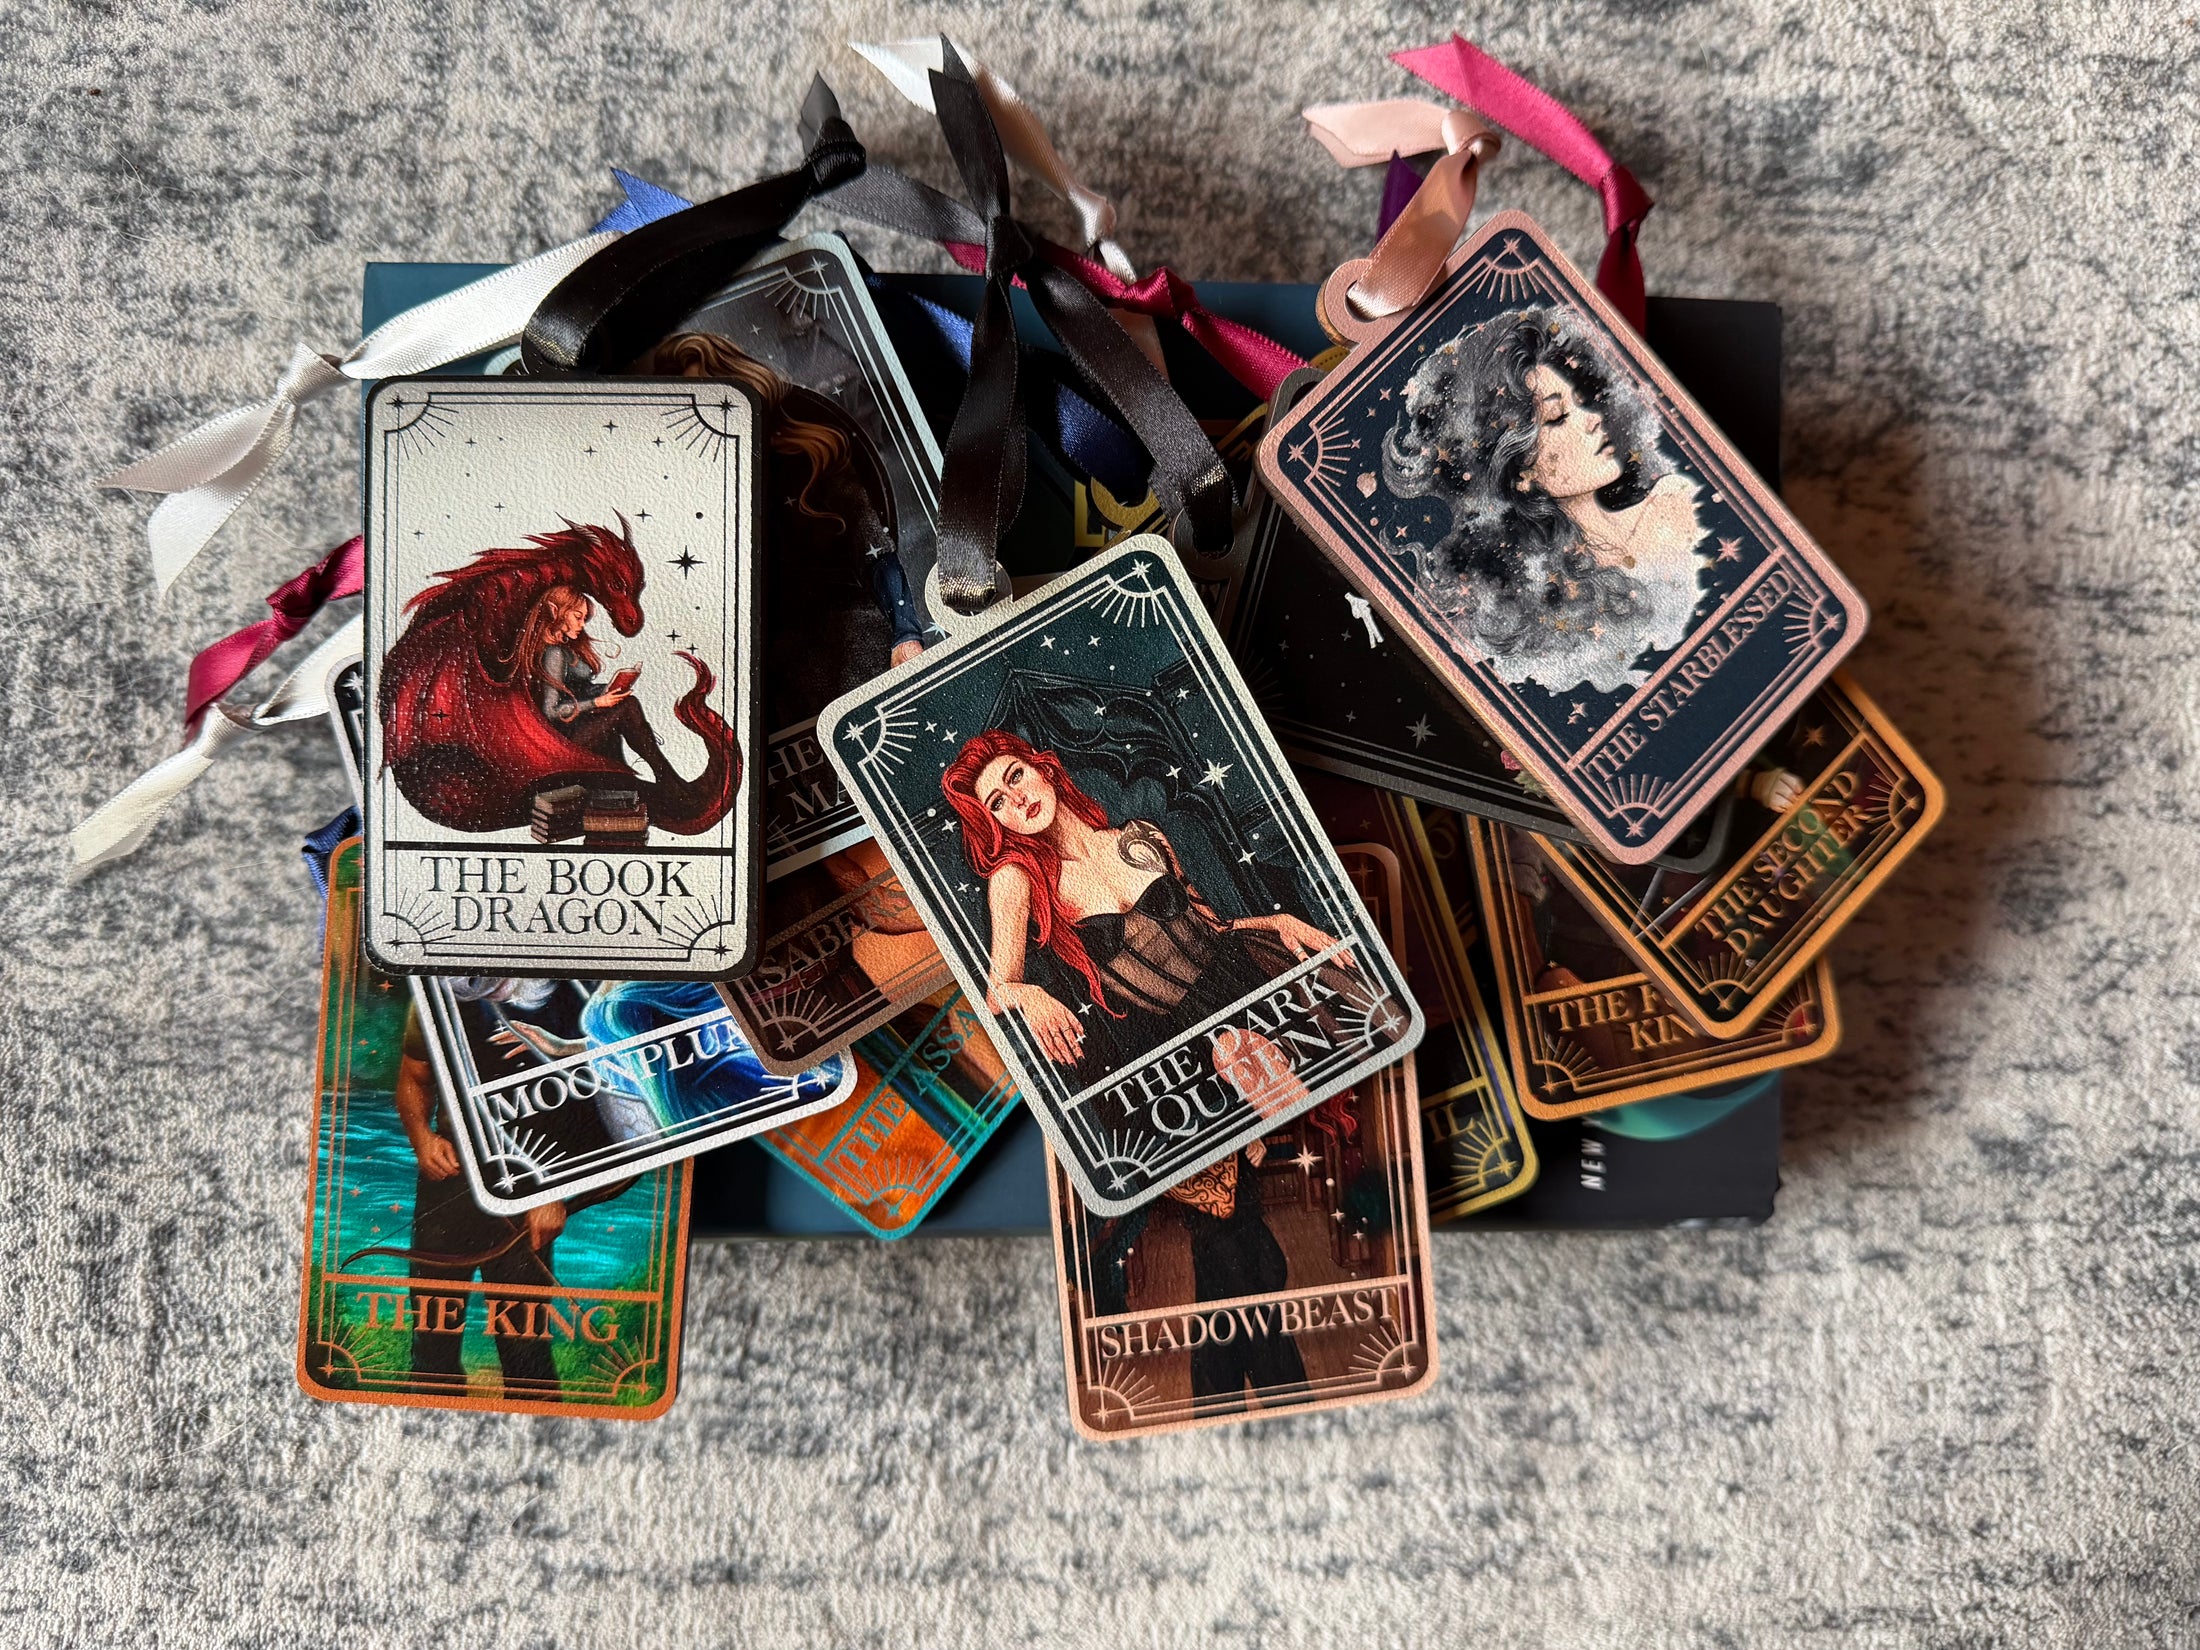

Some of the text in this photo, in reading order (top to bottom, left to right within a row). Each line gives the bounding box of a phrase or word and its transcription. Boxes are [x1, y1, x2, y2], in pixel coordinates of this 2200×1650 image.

[1585, 570, 1794, 782] THE STARBLESSED
[420, 856, 693, 897] THE BOOK
[1695, 771, 1858, 939] THE SECOND
[1723, 806, 1871, 957] DAUGHTER
[451, 896, 665, 935] DRAGON
[1105, 967, 1339, 1117] THE DARK
[1548, 990, 1631, 1032] THE
[1151, 1014, 1336, 1139] QUEEN
[835, 1087, 911, 1169] THE
[1580, 1137, 1607, 1192] NEW
[356, 1291, 621, 1342] THE KING
[1100, 1287, 1398, 1360] SHADOWBEAST
